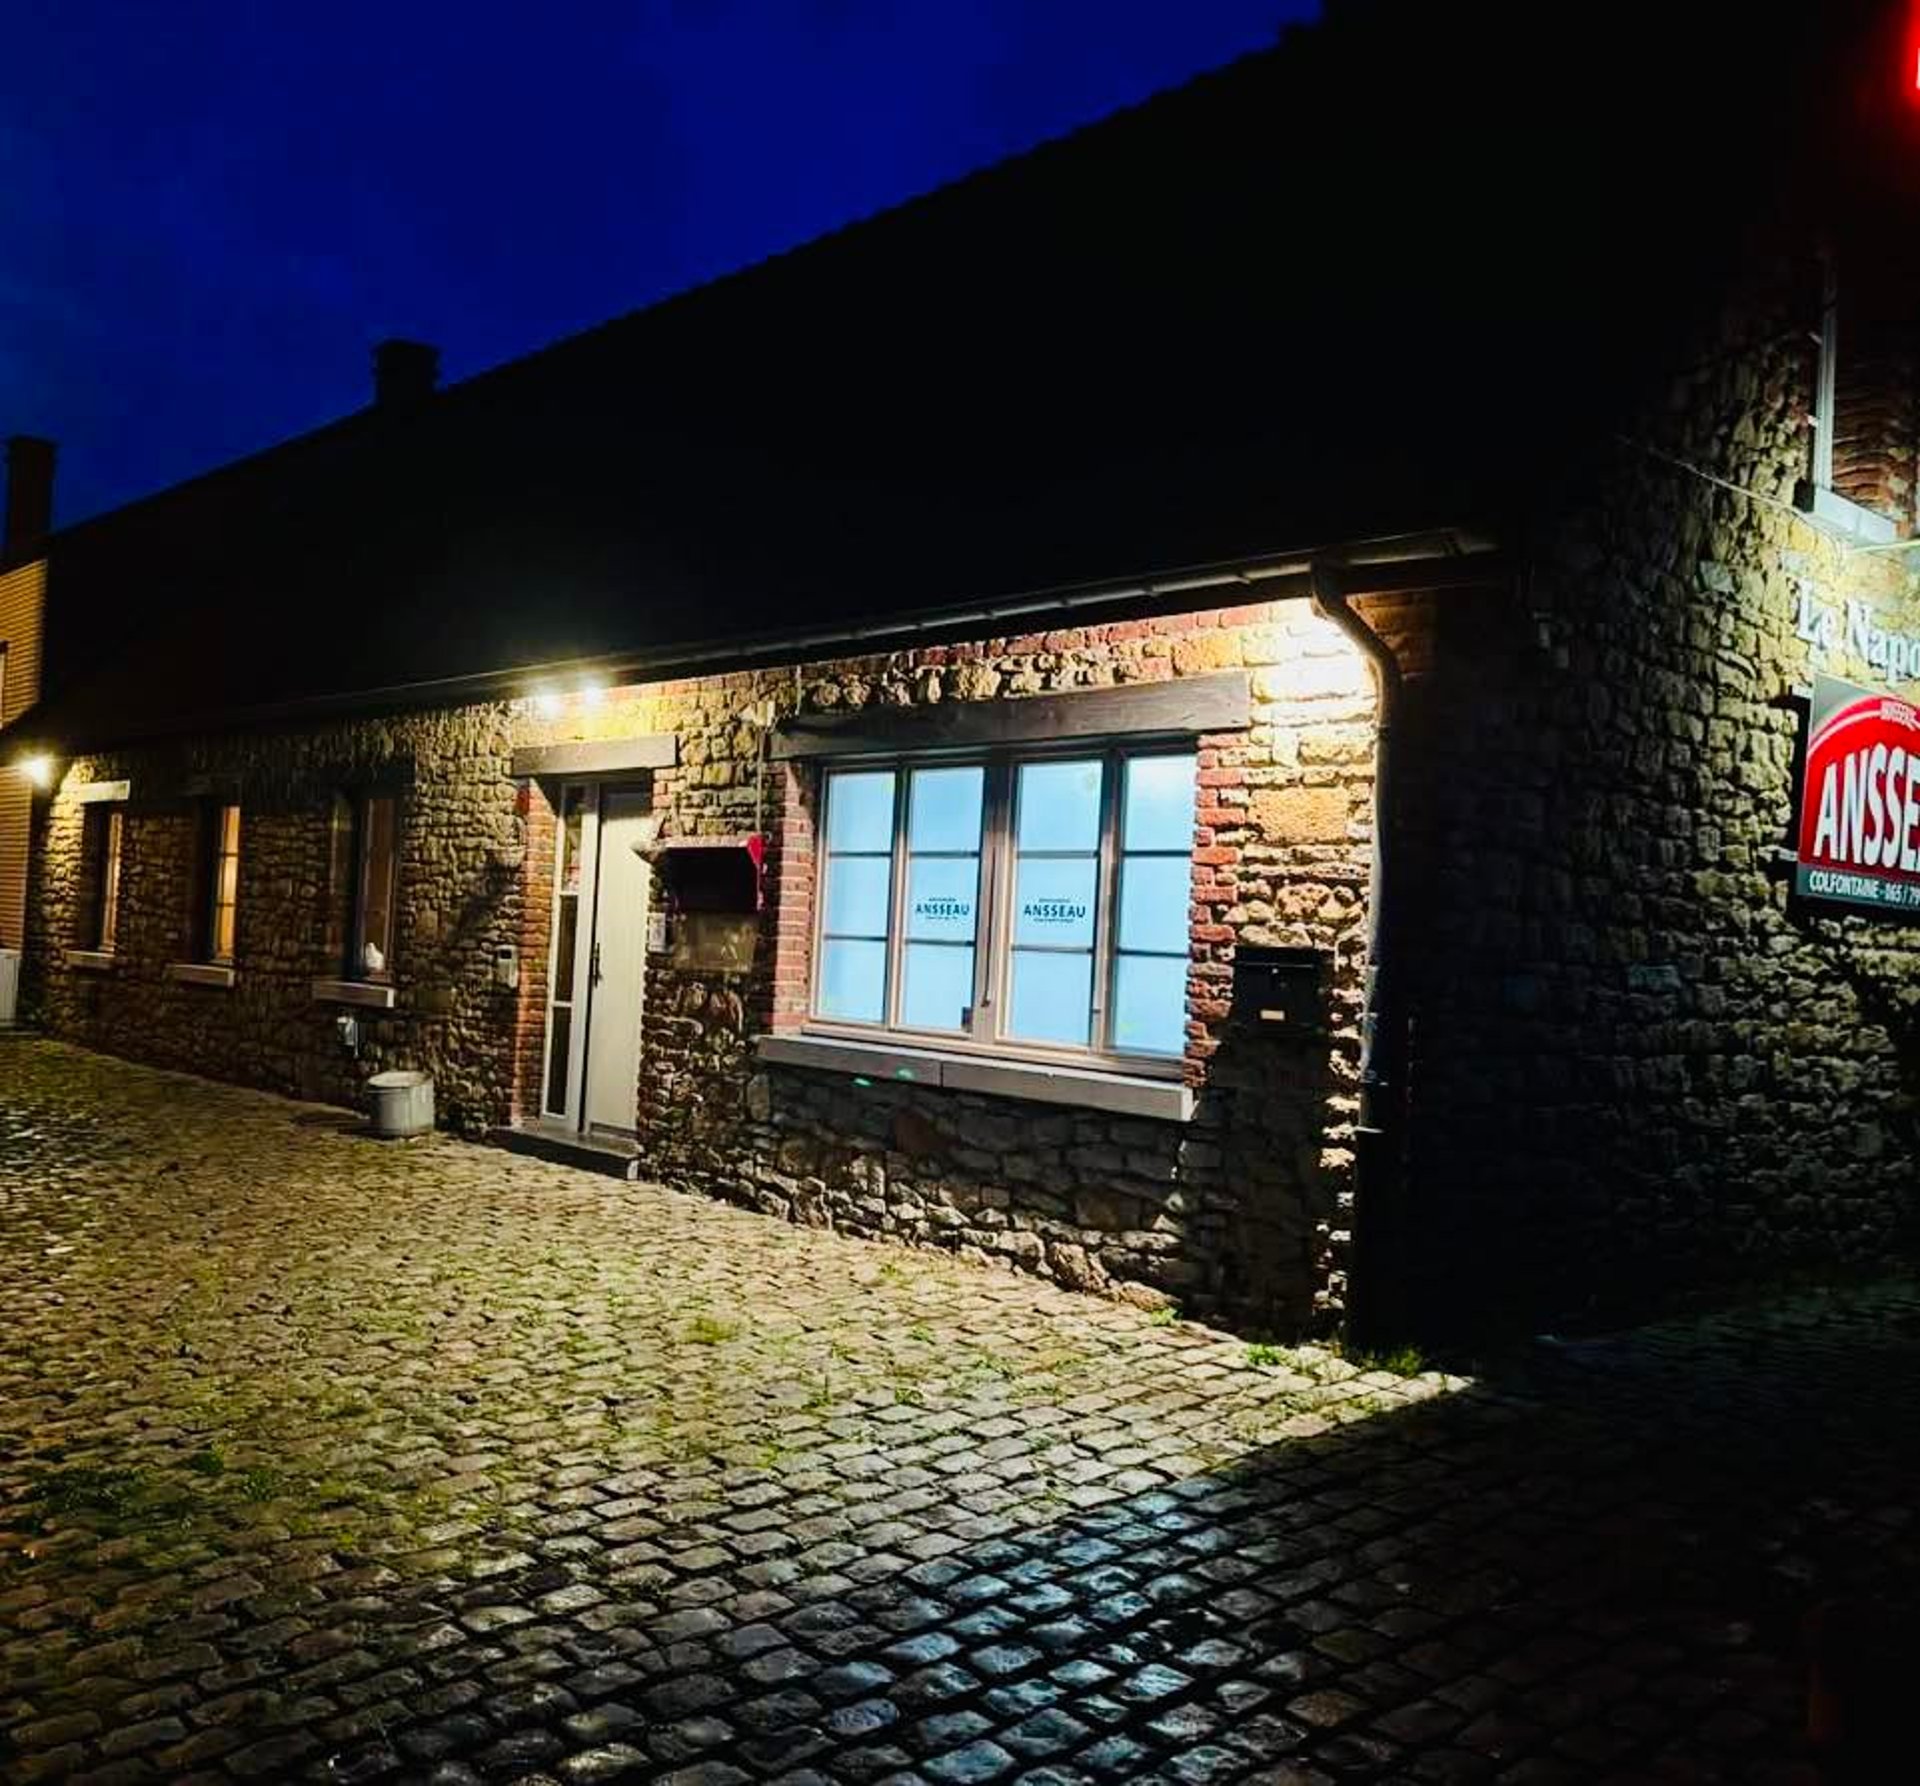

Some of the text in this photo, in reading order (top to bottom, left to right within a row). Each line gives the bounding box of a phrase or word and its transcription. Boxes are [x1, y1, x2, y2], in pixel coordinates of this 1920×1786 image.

[1797, 578, 1839, 650] Le
[1813, 742, 1920, 873] ANSSE
[1809, 870, 1879, 898] COLFONTAINE
[916, 903, 970, 916] ANSSEAU
[1024, 904, 1086, 918] ANSSEAU
